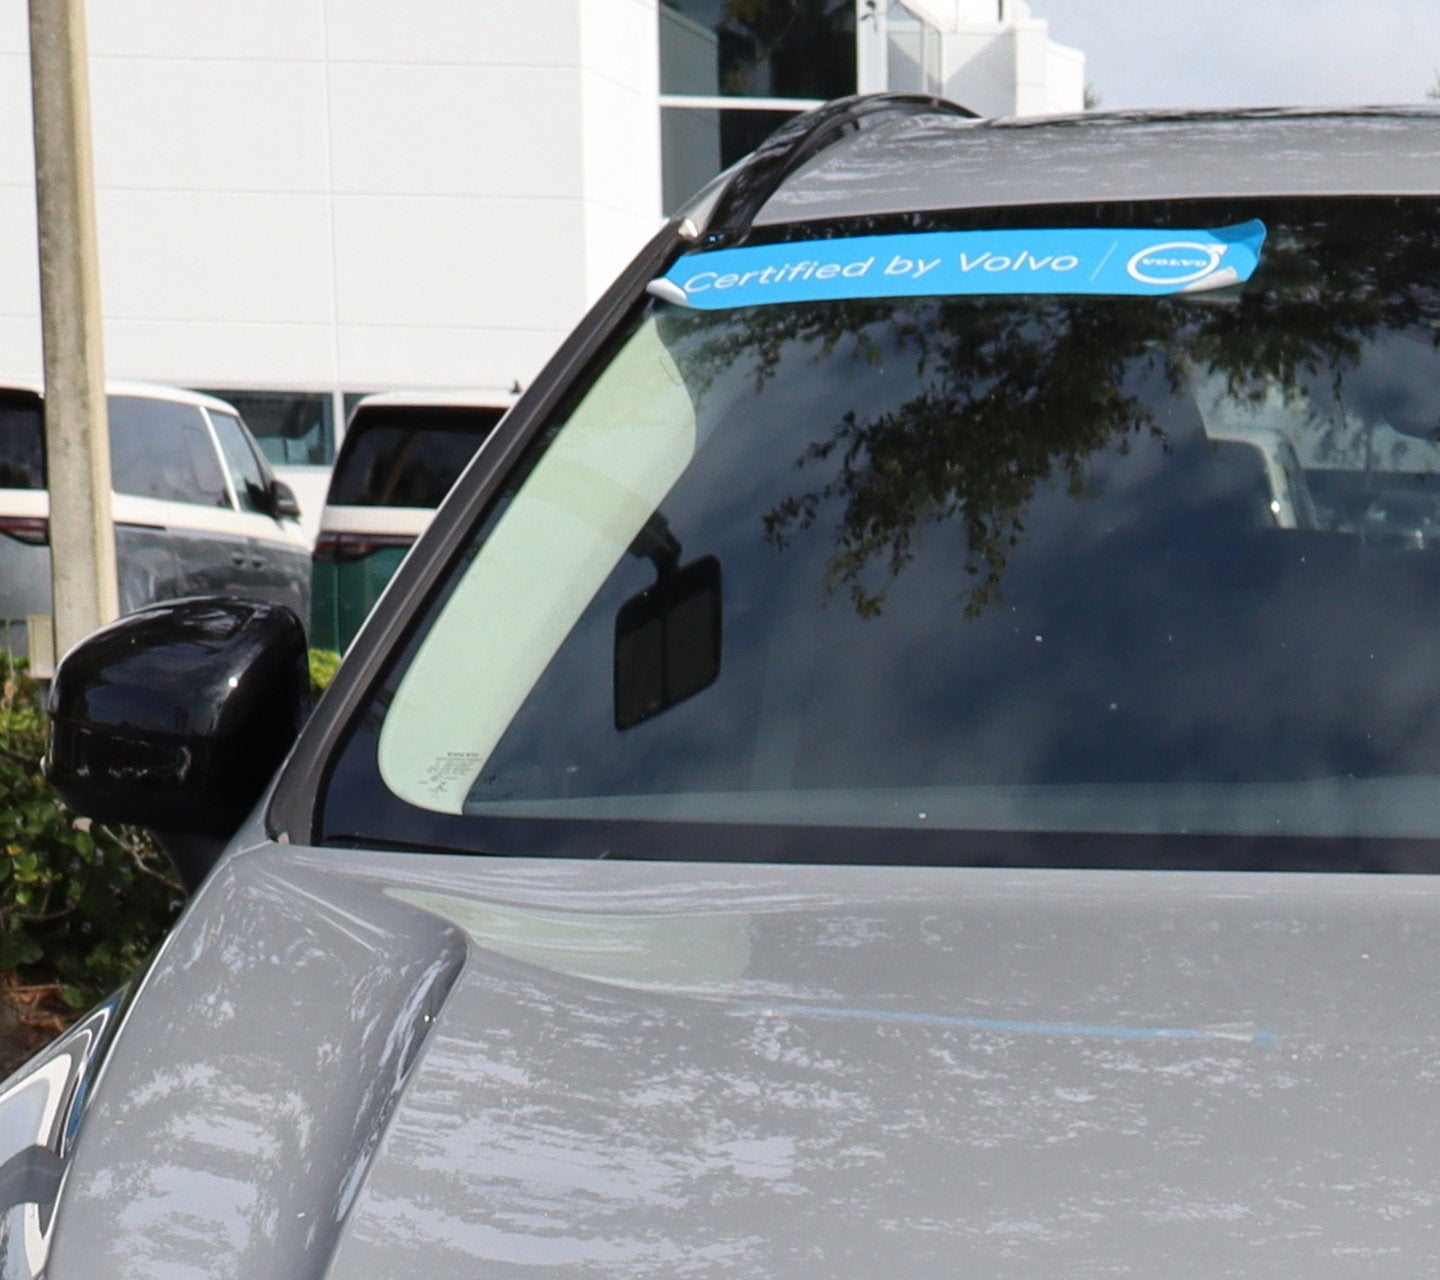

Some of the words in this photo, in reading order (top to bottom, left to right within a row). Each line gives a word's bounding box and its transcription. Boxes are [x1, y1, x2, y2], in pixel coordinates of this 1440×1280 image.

[683, 256, 875, 293] Certified
[884, 254, 942, 279] by
[960, 250, 1079, 272] Volvo
[1141, 257, 1208, 267] VOLVO
